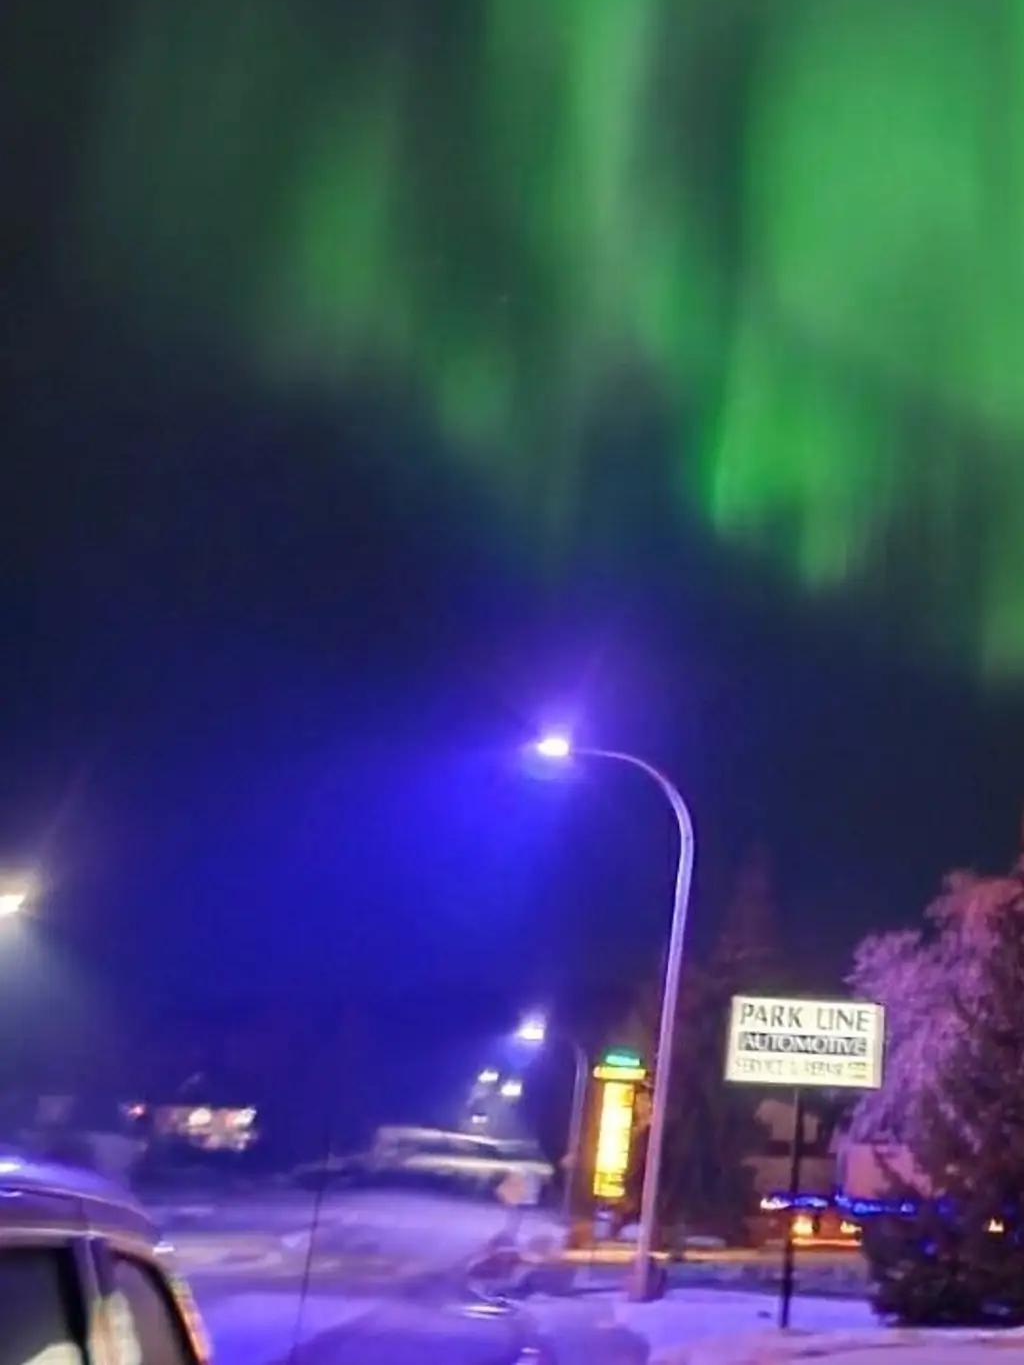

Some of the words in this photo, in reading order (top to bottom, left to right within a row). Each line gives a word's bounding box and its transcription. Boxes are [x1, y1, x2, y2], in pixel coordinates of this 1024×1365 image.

[740, 1003, 804, 1029] PARK
[816, 1007, 872, 1032] LINE
[741, 1032, 867, 1056] AUTOMOTIVE
